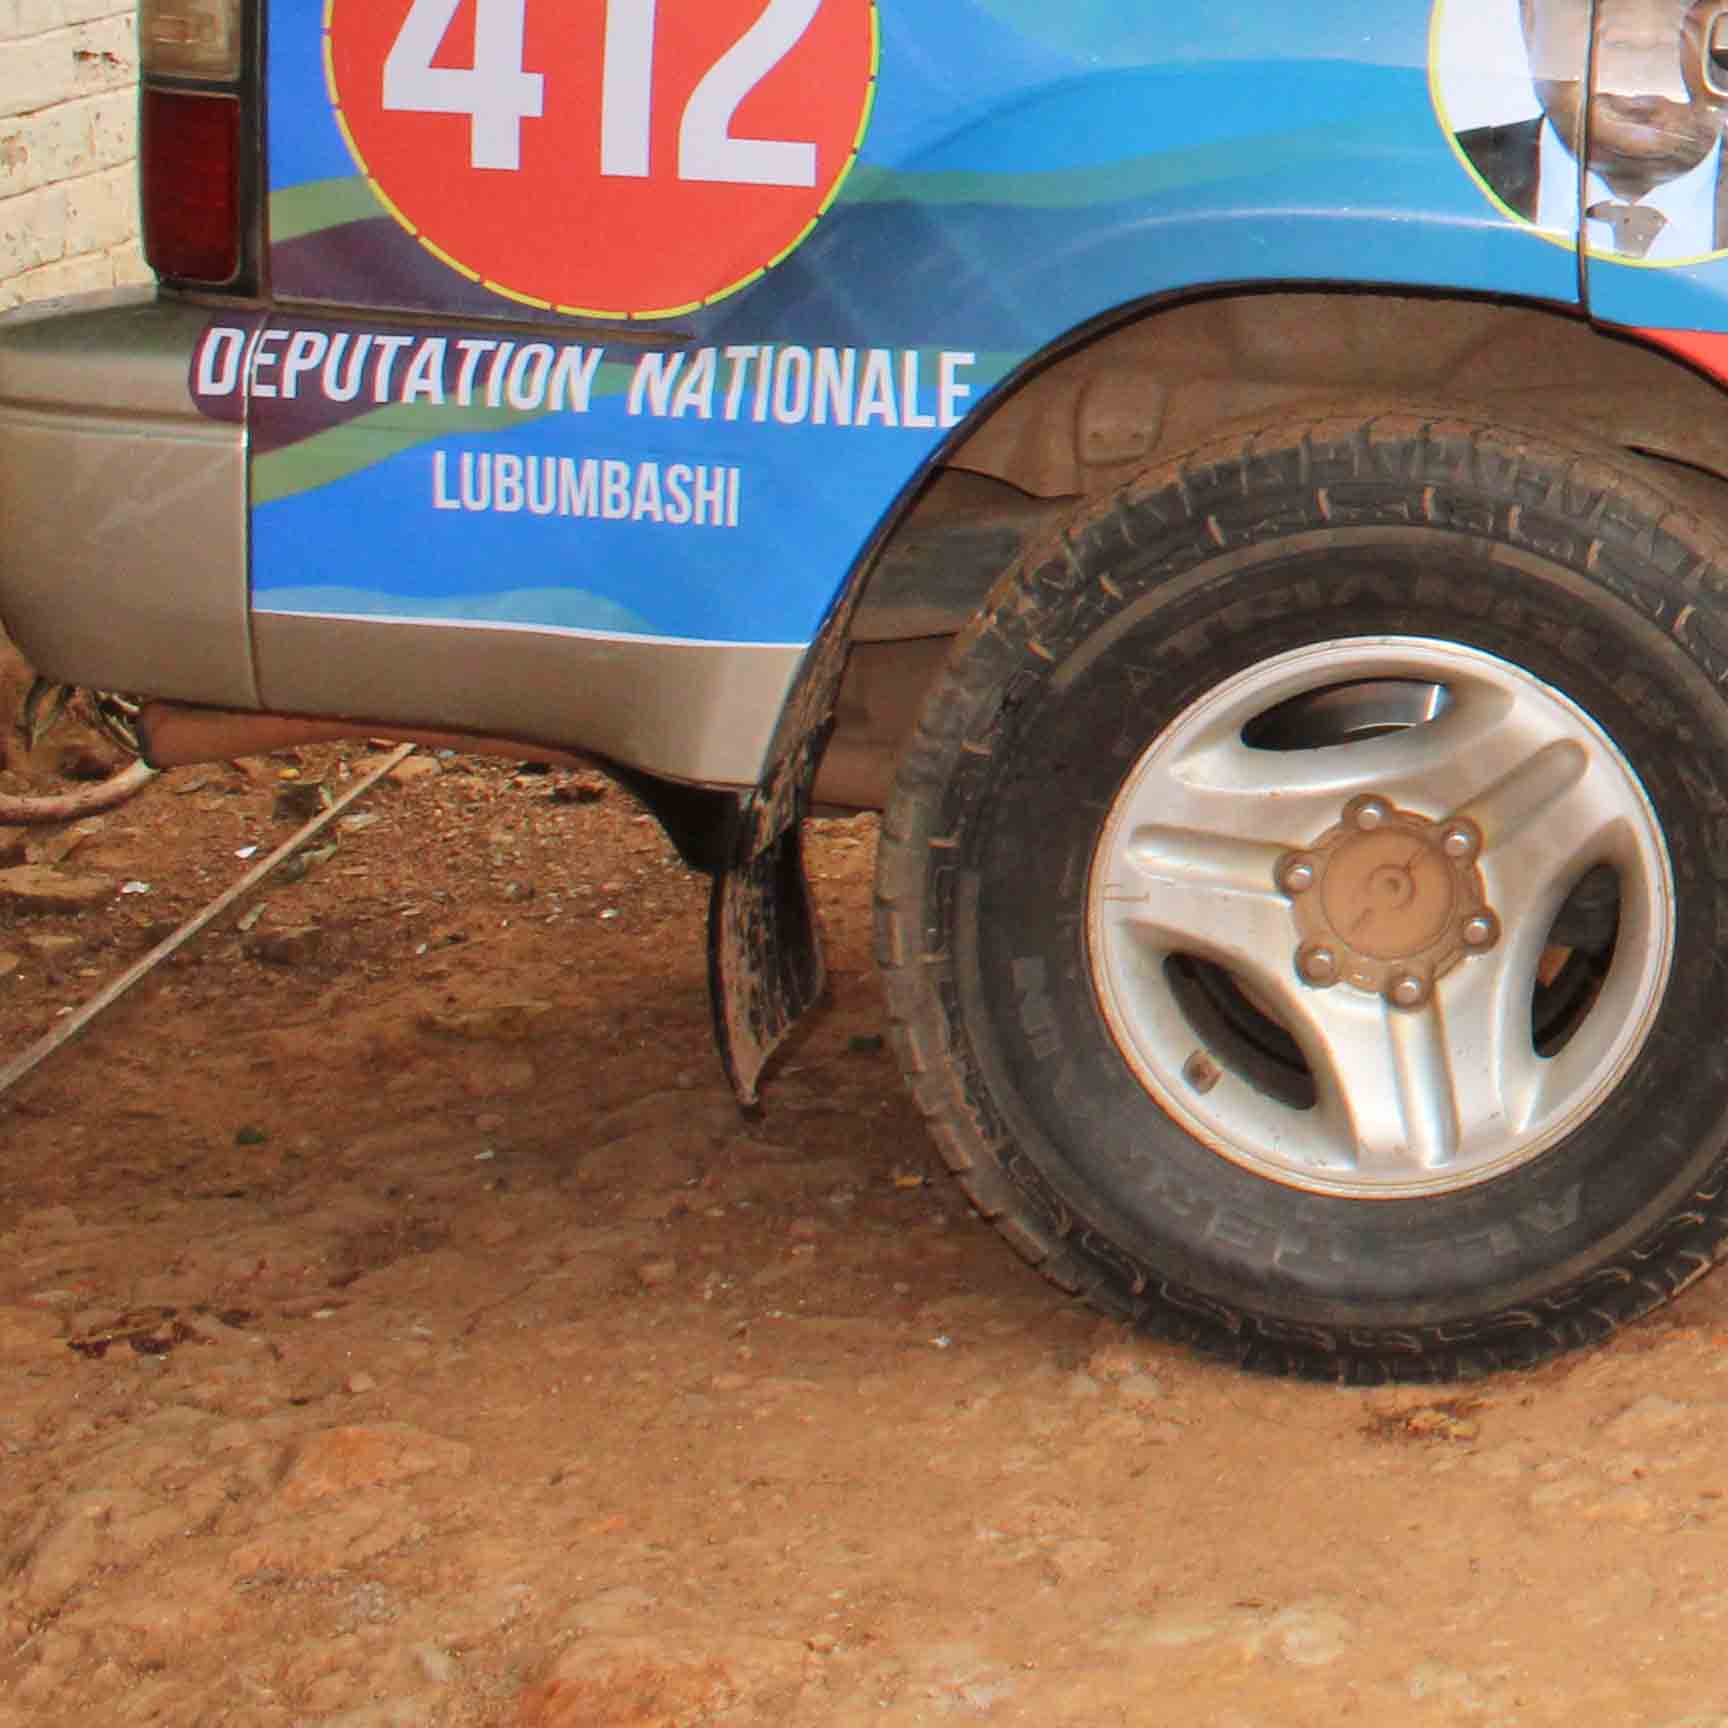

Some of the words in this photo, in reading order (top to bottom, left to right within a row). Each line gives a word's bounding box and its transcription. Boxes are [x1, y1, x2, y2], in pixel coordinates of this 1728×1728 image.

[196, 327, 602, 413] DEPUTATION
[627, 345, 976, 428] NATIONALE
[434, 450, 741, 527] LUBUMBASHI
